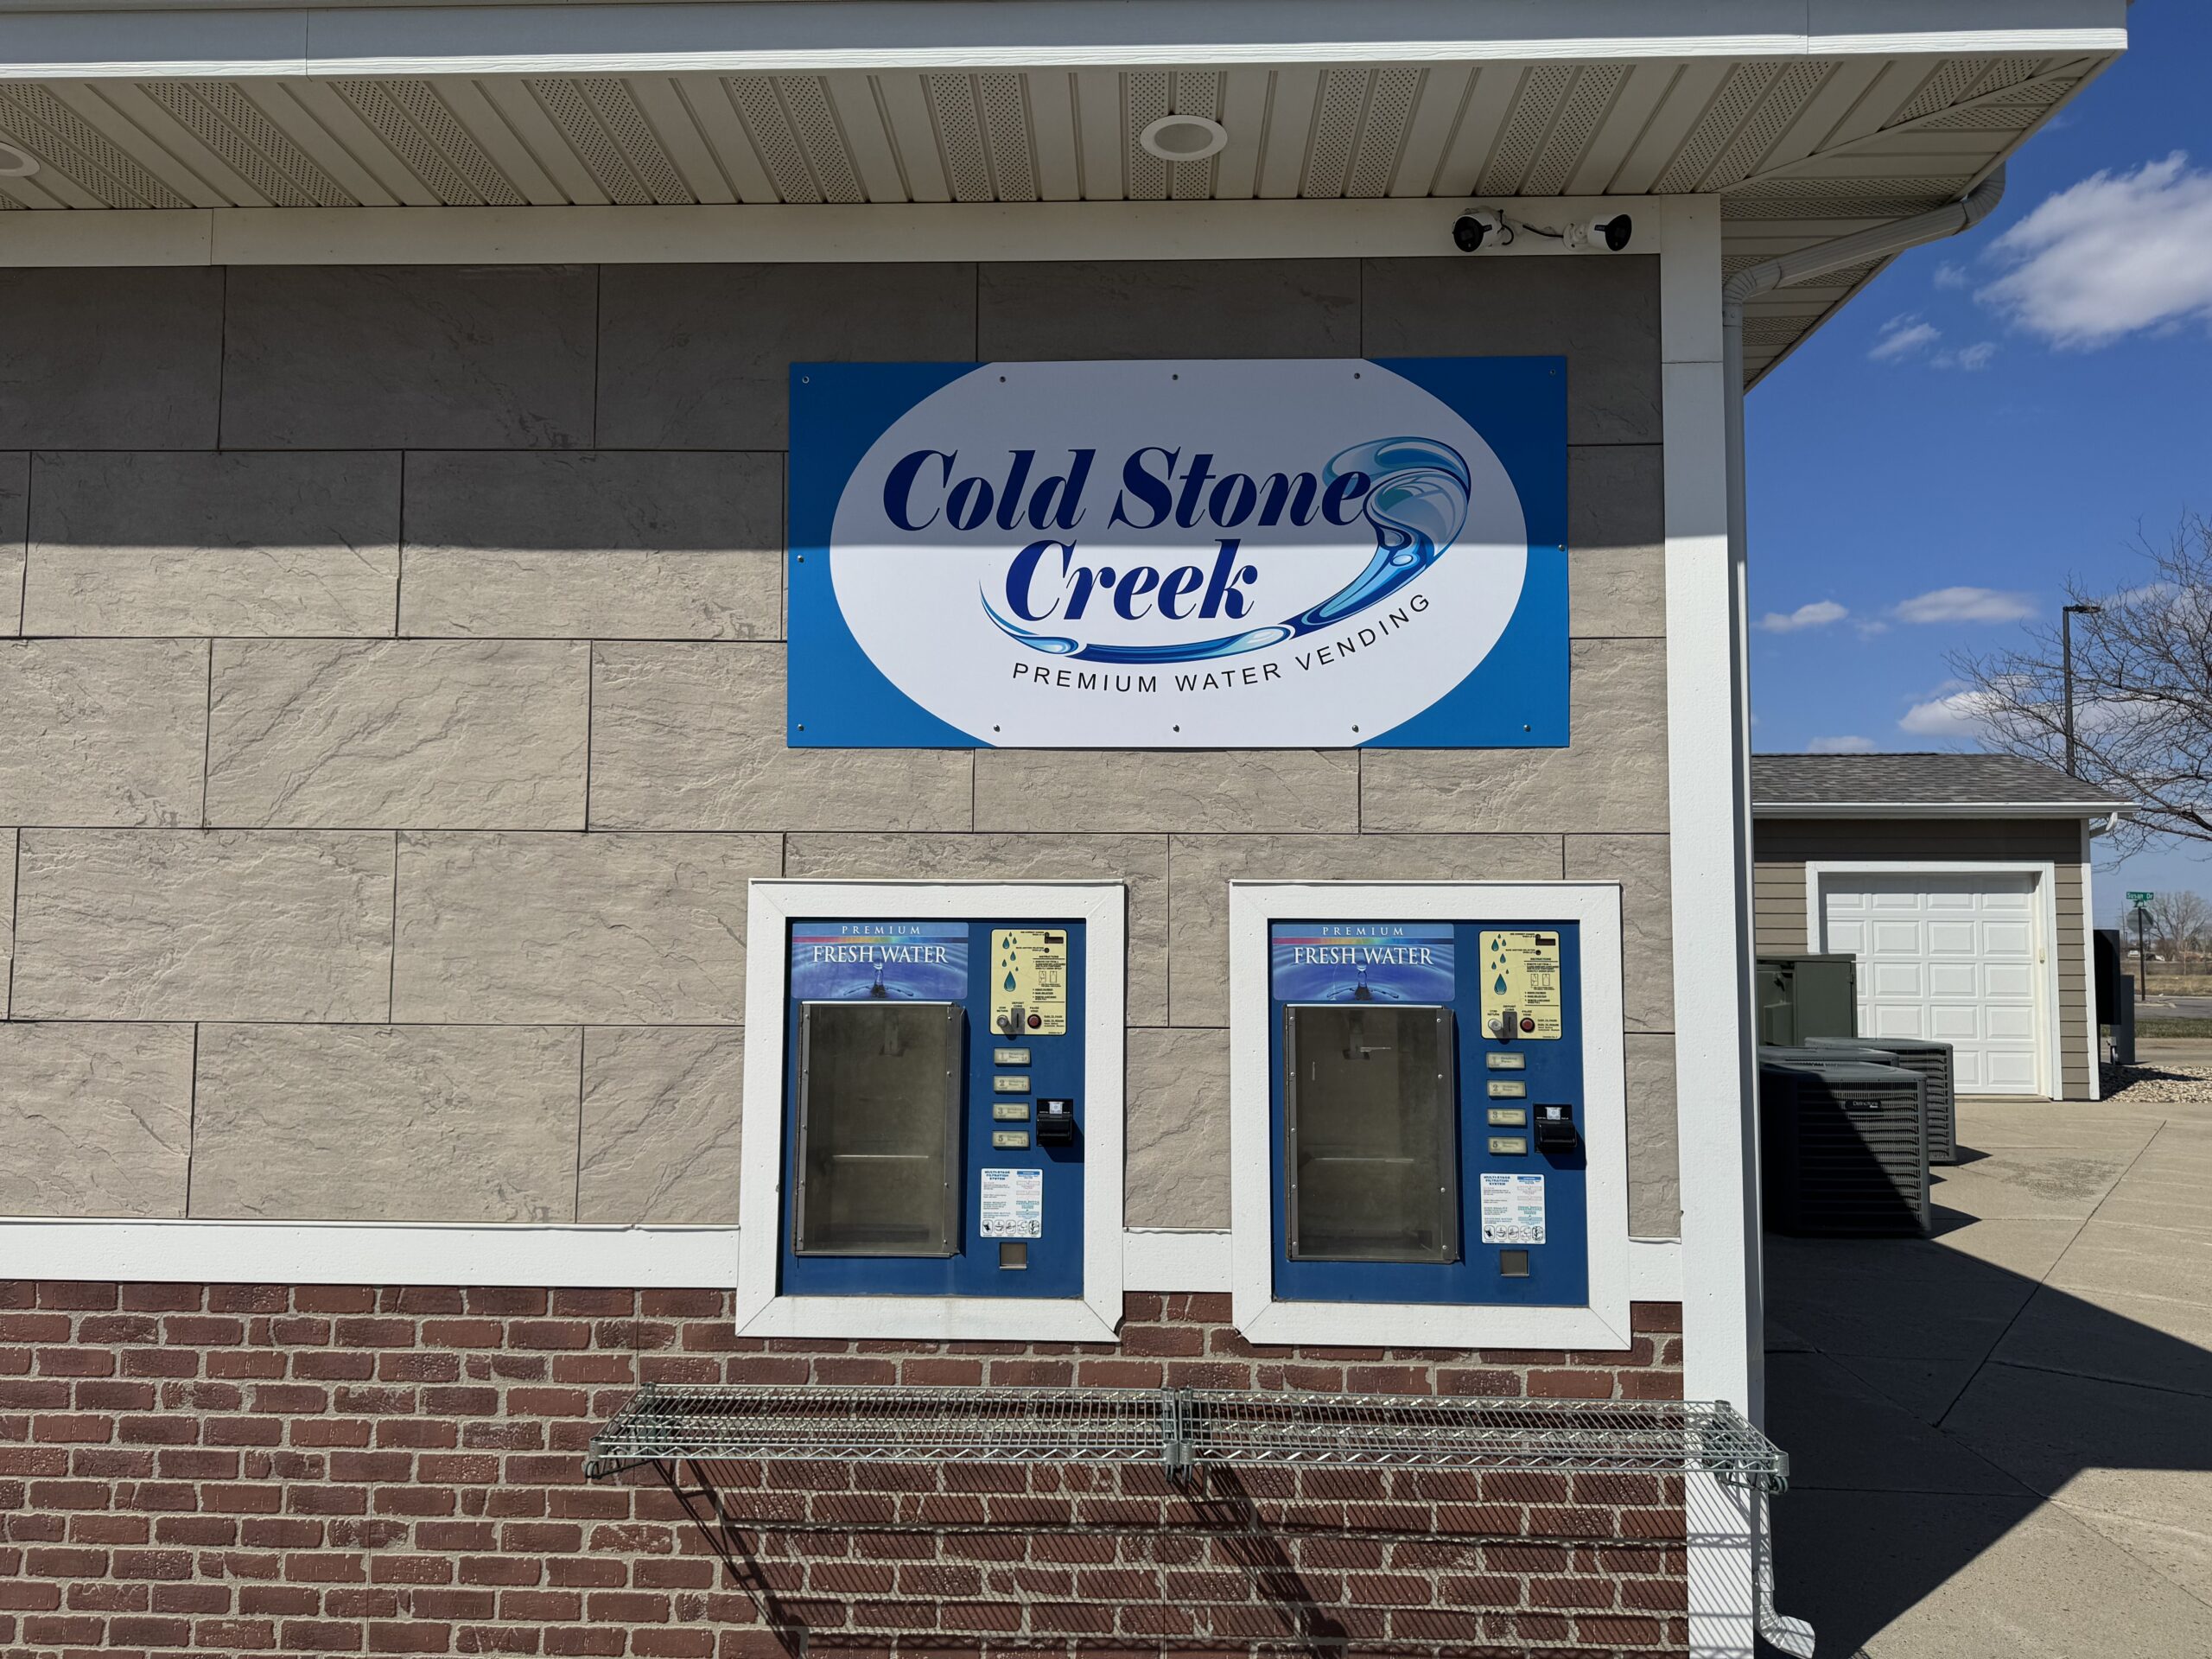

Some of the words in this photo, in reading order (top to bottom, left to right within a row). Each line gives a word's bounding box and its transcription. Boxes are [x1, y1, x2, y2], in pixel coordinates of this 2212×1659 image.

[883, 448, 1096, 531] Cold
[1107, 445, 1374, 530] Stone
[1005, 538, 1258, 621] Creek
[1012, 662, 1158, 694] PREMIUM
[1174, 662, 1282, 693] WATER
[1294, 593, 1431, 671] VENDING
[842, 925, 920, 934] PREMIUM
[1322, 926, 1404, 936] PREMIUM
[812, 945, 874, 963] FRESH
[880, 945, 949, 963] WATER
[1294, 947, 1357, 964] FRESH
[1362, 947, 1434, 965] WATER
